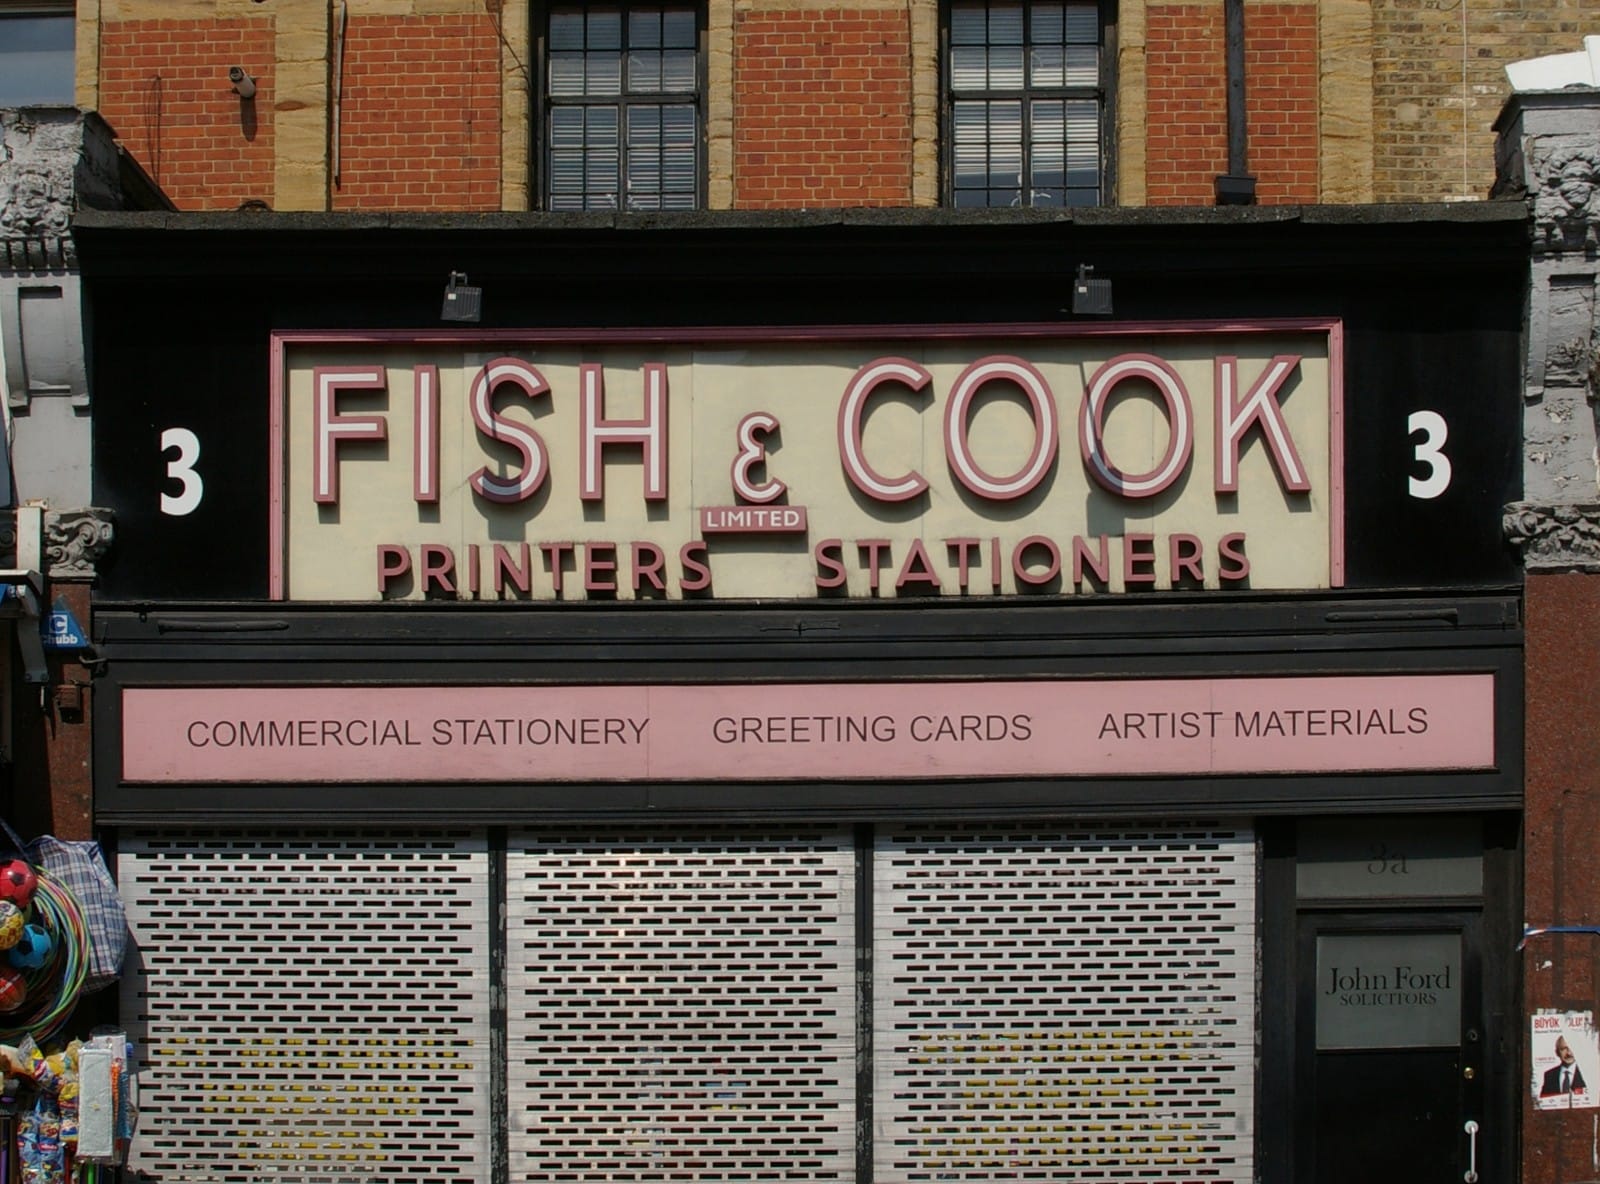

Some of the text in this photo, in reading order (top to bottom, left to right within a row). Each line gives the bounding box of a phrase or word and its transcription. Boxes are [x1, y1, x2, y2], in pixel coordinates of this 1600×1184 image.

[313, 352, 1311, 503] FISH & COOK
[1408, 410, 1452, 499] 3
[160, 427, 203, 516] 3
[706, 510, 800, 528] LIMITED
[376, 532, 1251, 593] PRINTERS STATIONERS
[187, 718, 650, 747] COMMERCIAL STATIONERY
[712, 714, 1033, 744] GREETING CARDS
[1098, 707, 1429, 740] ARTIST MATERIALS
[1367, 842, 1409, 875] 3a
[1326, 965, 1452, 995] John Ford
[1339, 991, 1437, 1007] SOLICITORS
